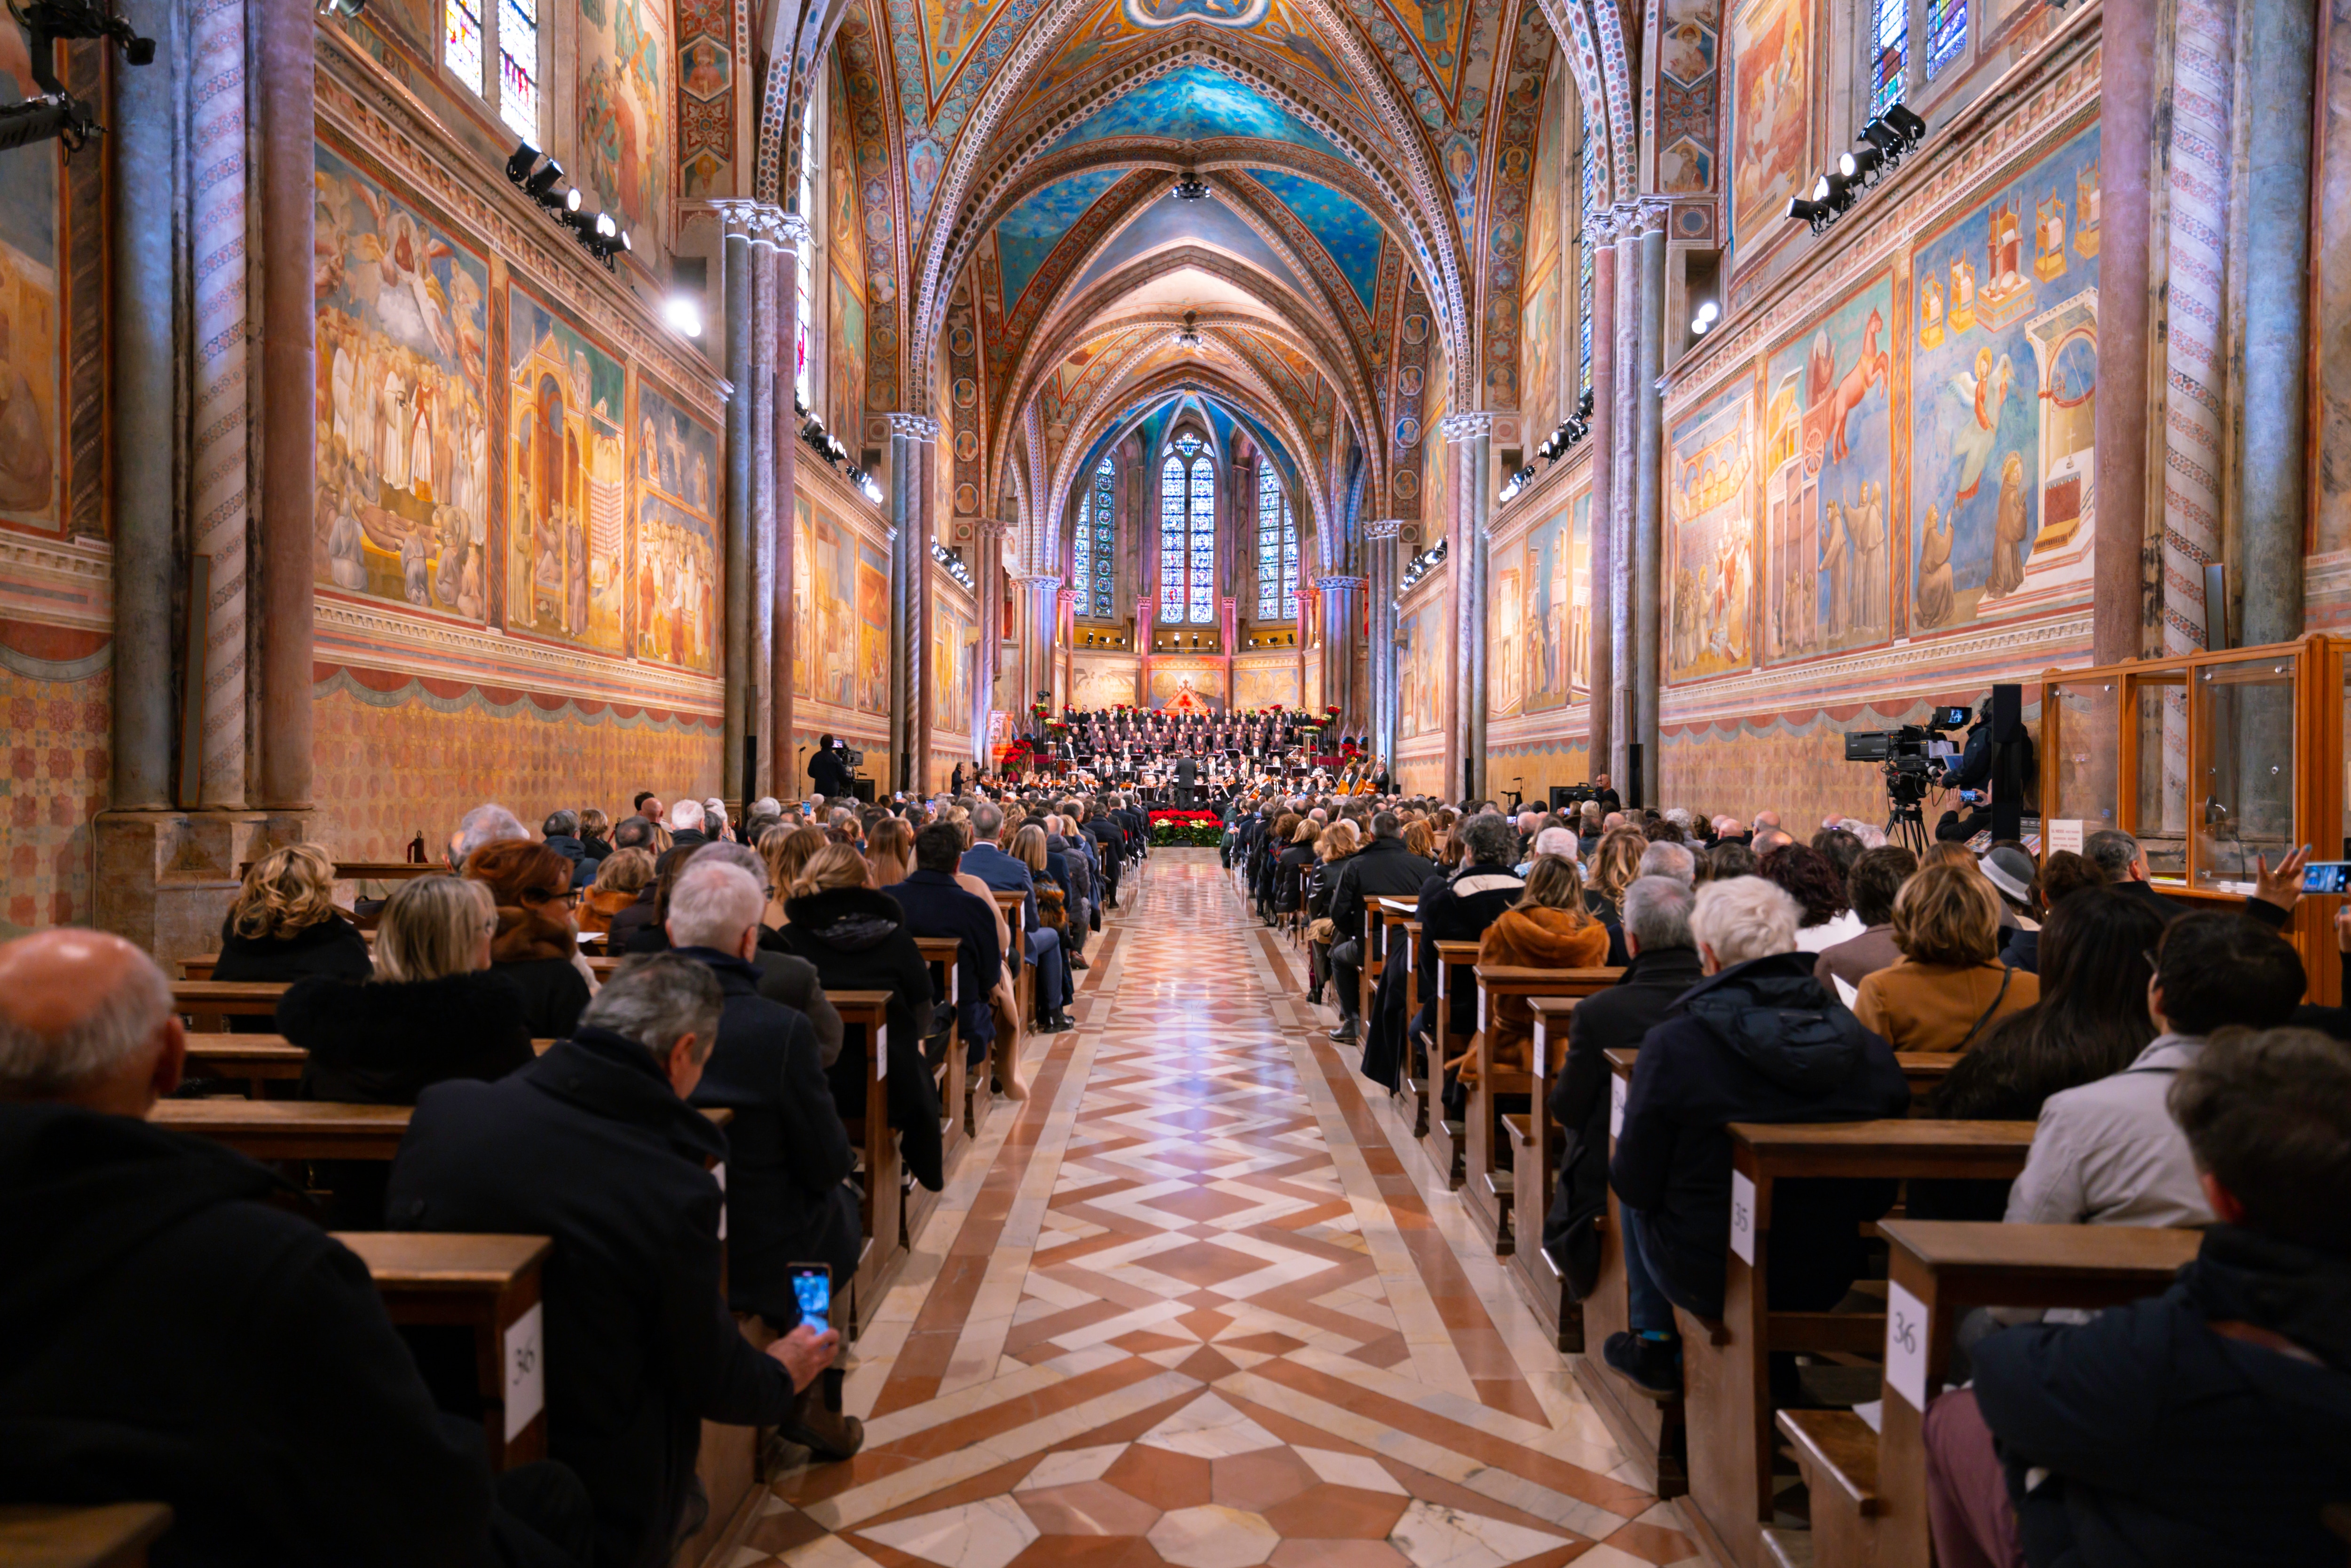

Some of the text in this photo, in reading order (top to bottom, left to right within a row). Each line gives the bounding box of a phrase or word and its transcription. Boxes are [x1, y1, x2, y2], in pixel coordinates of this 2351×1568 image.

[1734, 1202, 1748, 1233] 35
[1893, 1311, 1917, 1355] 36
[512, 1335, 536, 1386] 36
